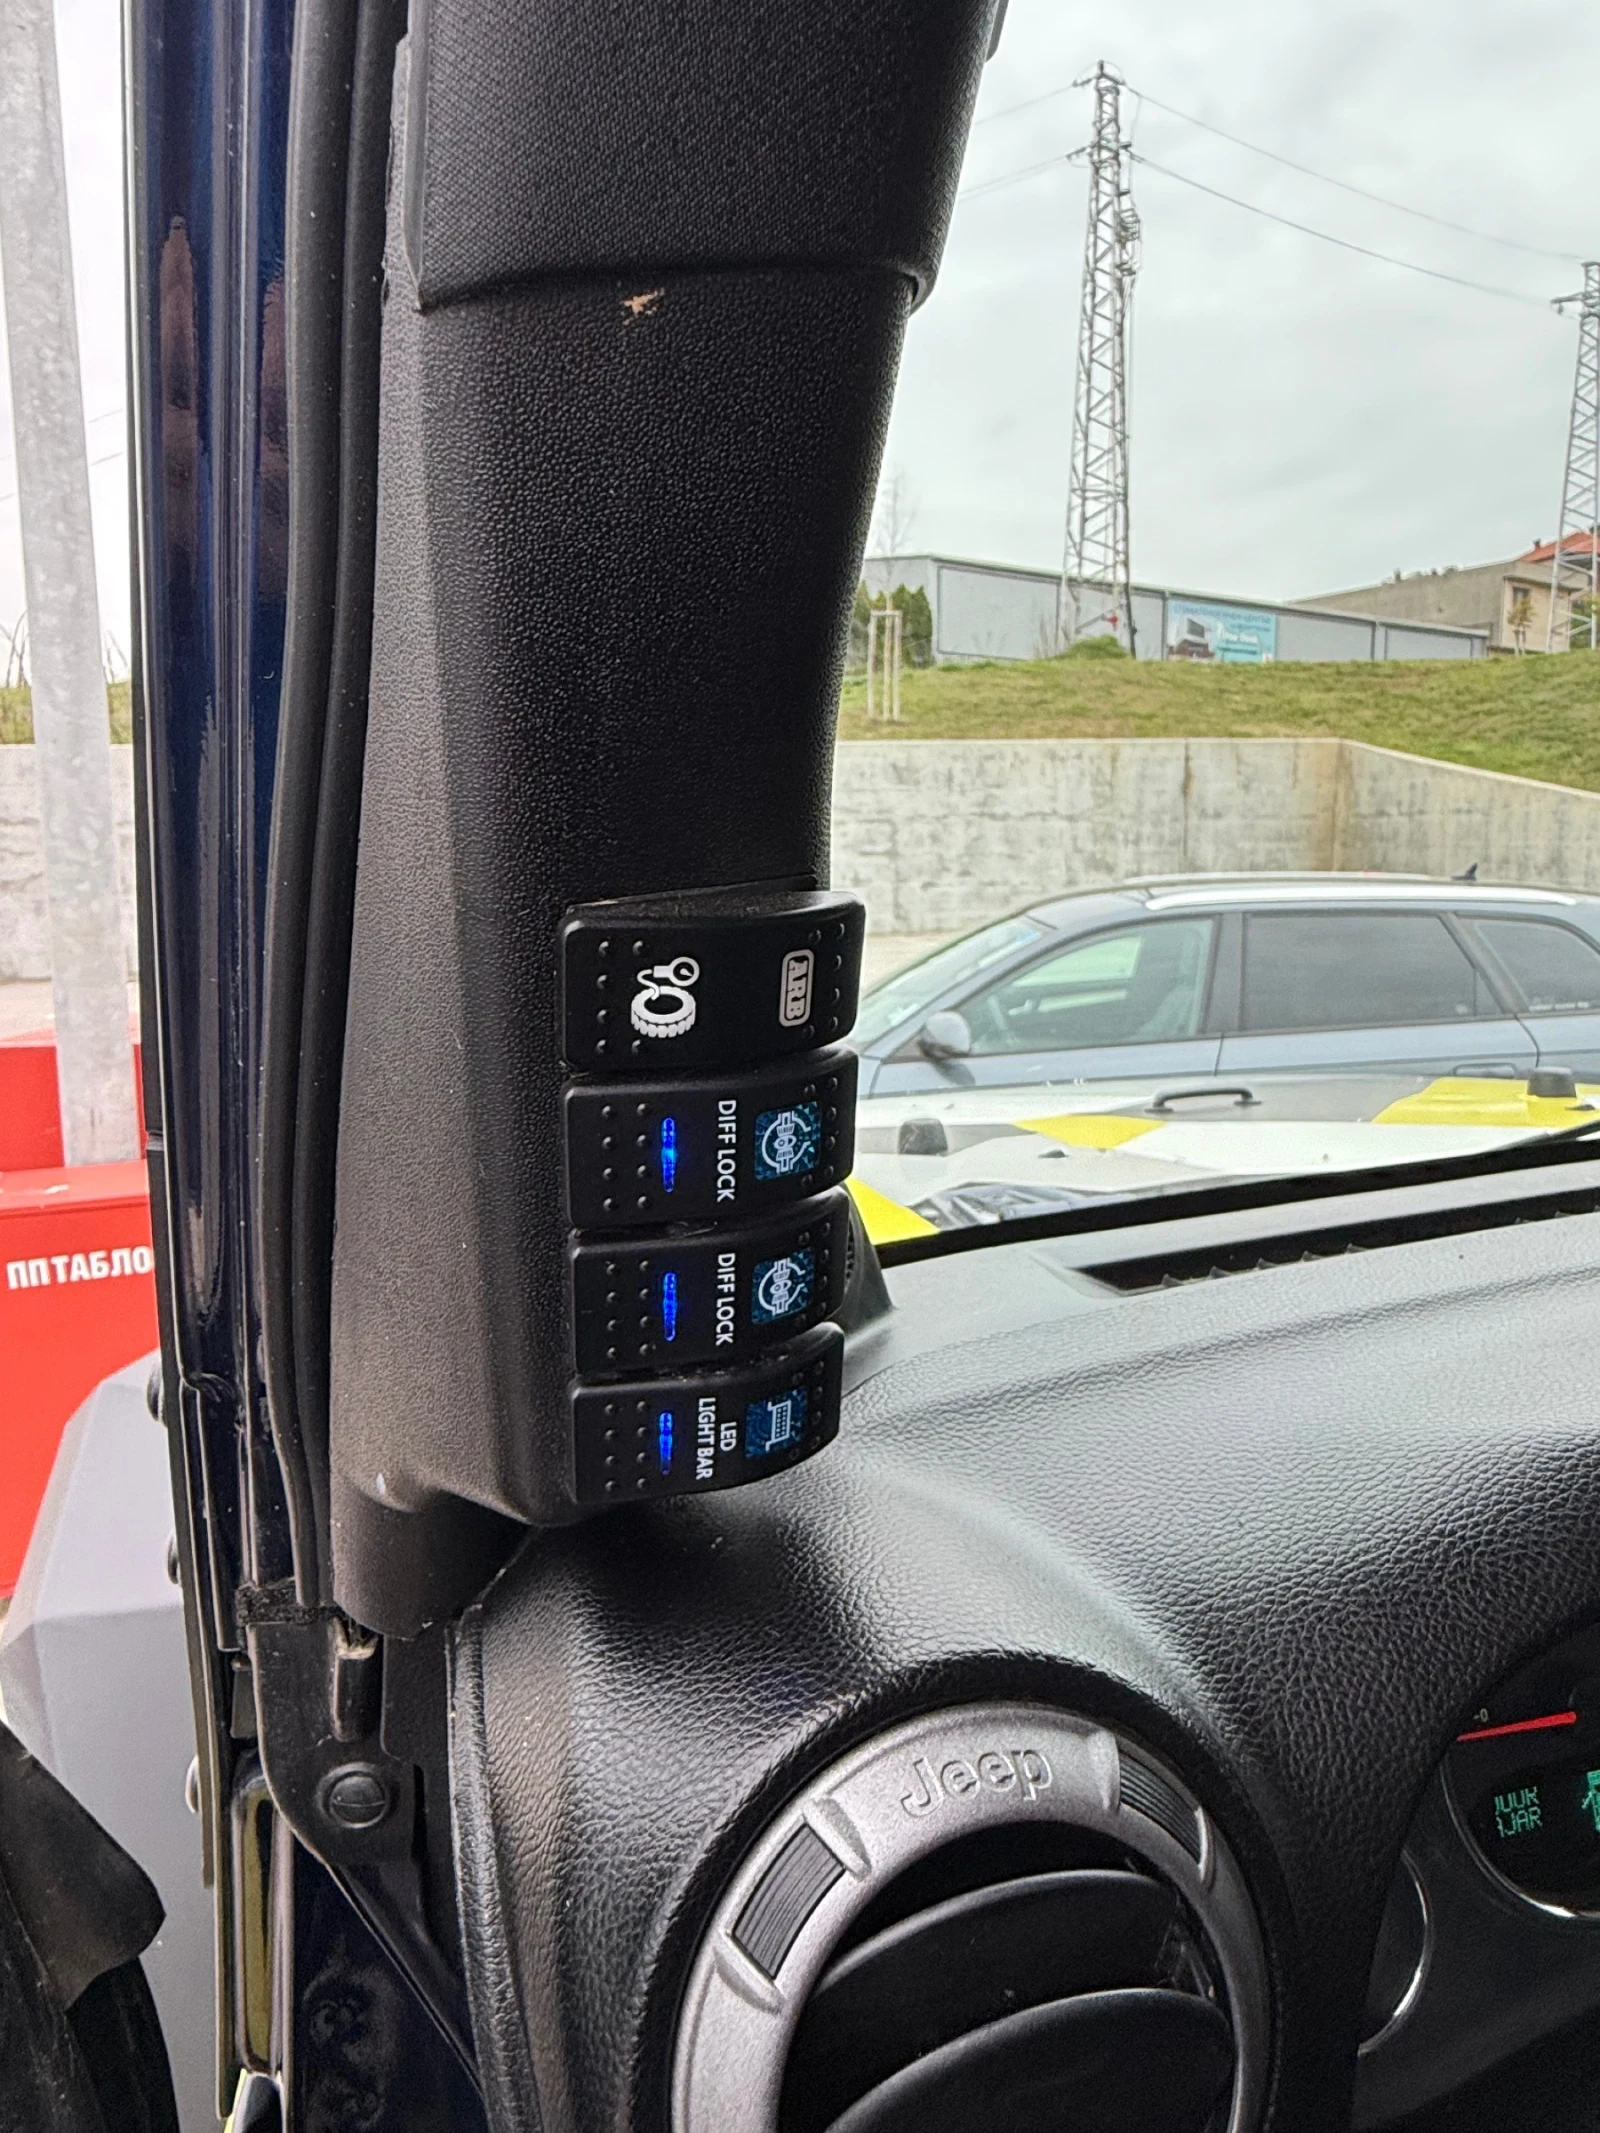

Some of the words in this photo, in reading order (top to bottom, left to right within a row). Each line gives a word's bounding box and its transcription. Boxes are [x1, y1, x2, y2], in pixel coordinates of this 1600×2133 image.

[785, 959, 808, 1020] ARB
[717, 1099, 737, 1145] DIFF
[716, 1149, 737, 1202] LOCK
[717, 1253, 736, 1294] DIFF
[715, 1298, 736, 1345] LOCK
[697, 1397, 716, 1443] LIGHT
[720, 1421, 737, 1451] LED
[695, 1445, 715, 1480] BAR
[900, 1749, 1052, 1816] Jeep
